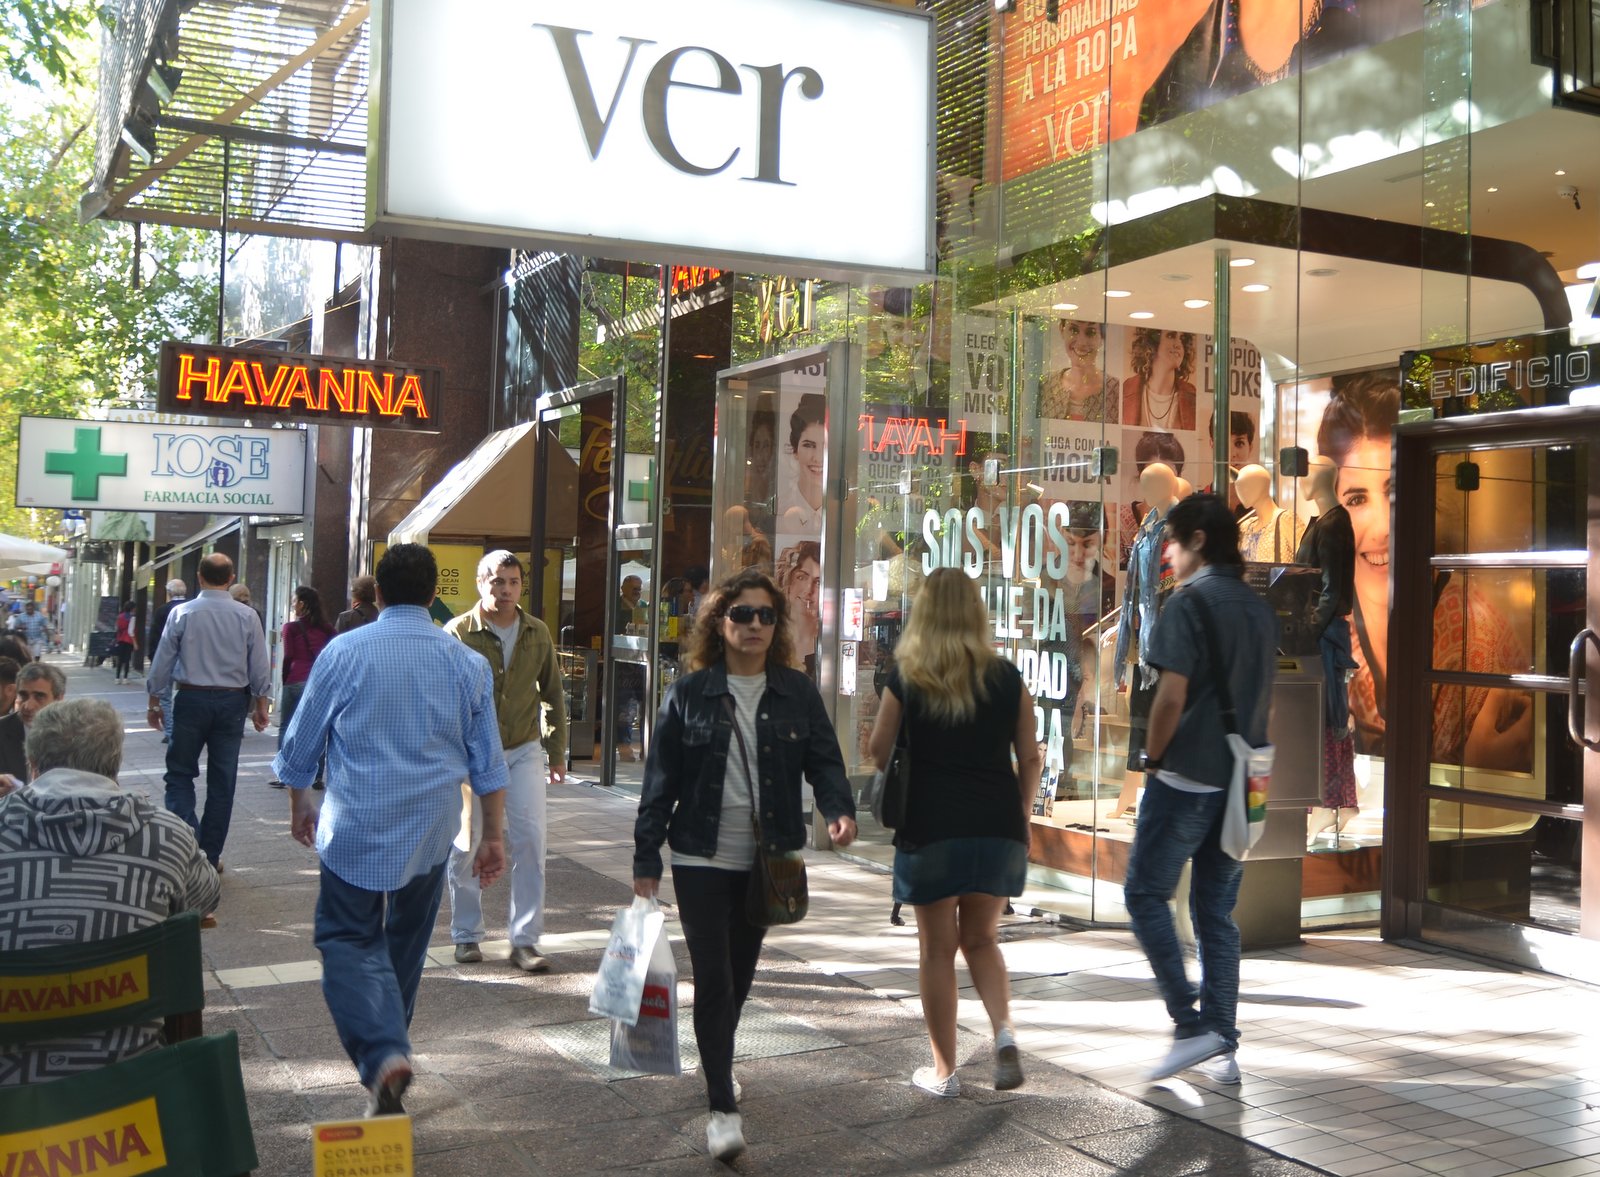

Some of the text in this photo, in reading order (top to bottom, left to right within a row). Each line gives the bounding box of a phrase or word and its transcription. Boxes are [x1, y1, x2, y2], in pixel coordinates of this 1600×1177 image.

[1022, 15, 1137, 104] A LA ROPA
[531, 23, 824, 187] ver
[1042, 89, 1111, 162] ver
[967, 333, 998, 350] ELEG
[176, 354, 429, 418] HAVANNA
[966, 352, 1024, 393] VO
[1204, 366, 1261, 398] LOKS
[1430, 350, 1590, 400] EDIFICIO
[152, 433, 269, 488] IOSE
[1074, 437, 1095, 451] CON
[1043, 452, 1112, 485] MOD
[144, 491, 274, 505] FARMACIA SOCIAL
[922, 502, 1070, 580] SOS VOS
[1033, 587, 1067, 642] DA
[0, 972, 139, 1013] AVANNA
[323, 1143, 403, 1159] COMELOS
[324, 1163, 404, 1177] GRANDES
